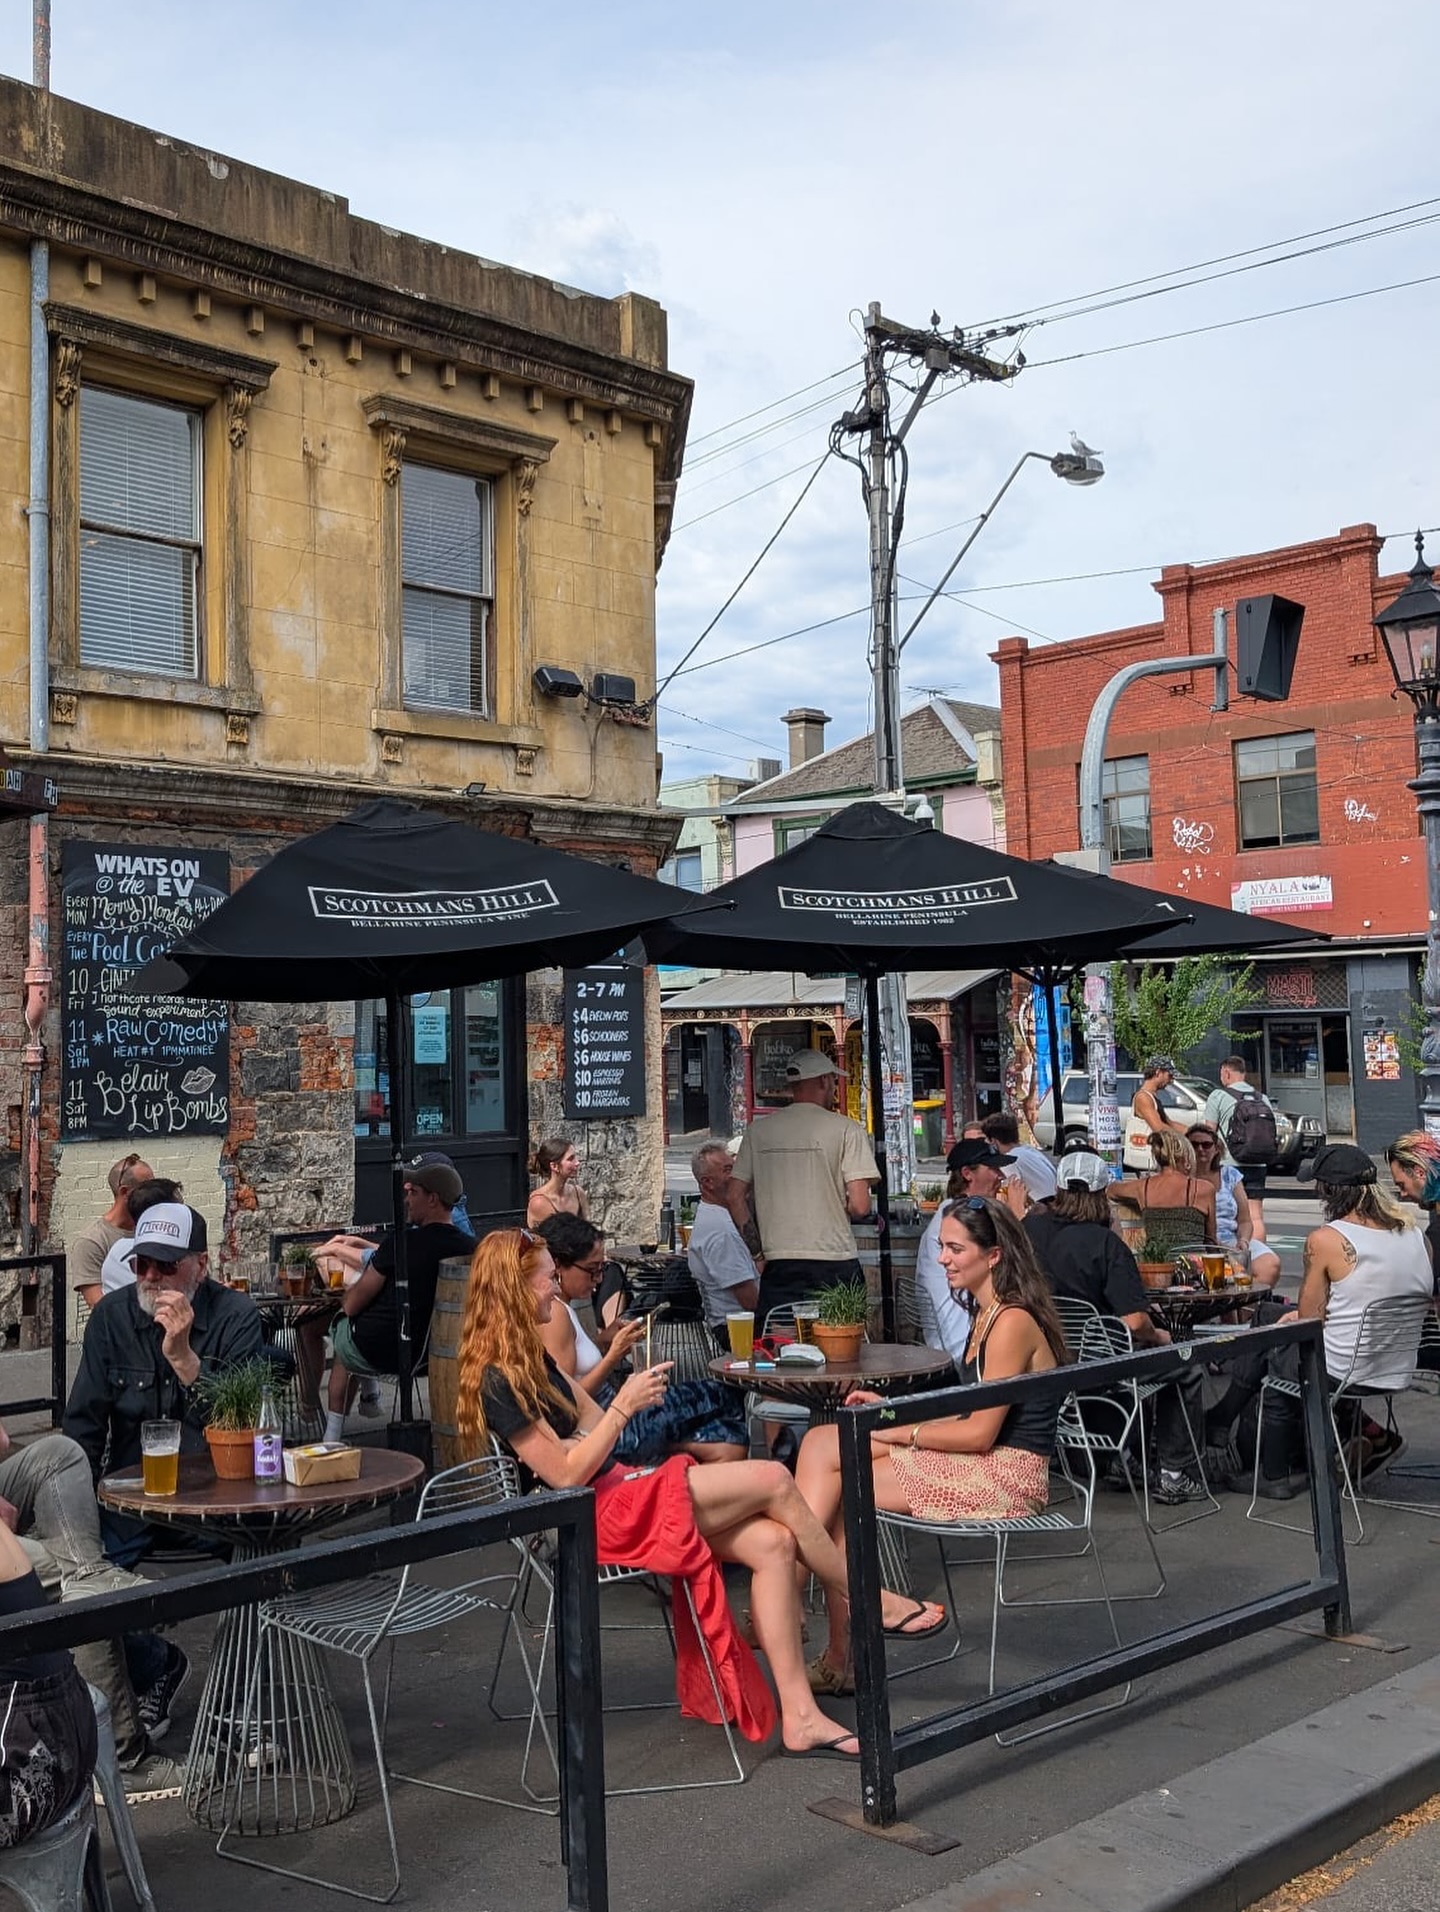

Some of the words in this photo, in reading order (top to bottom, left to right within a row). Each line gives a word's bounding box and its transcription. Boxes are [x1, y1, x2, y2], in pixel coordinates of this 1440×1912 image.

[95, 853, 168, 876] WHATS
[170, 859, 200, 878] ON
[95, 875, 114, 894] @
[118, 875, 146, 895] the
[157, 877, 194, 897] EV
[1250, 881, 1299, 896] NYALA
[66, 895, 90, 908] EVERY
[325, 894, 476, 914] SCOTCHMANS
[480, 891, 542, 912] HILL
[792, 893, 936, 908] SCOTCHMANS
[941, 886, 1001, 903] HILL
[66, 909, 88, 926] MON
[92, 895, 143, 923] Merry
[902, 910, 969, 919] PENINSULA
[66, 930, 92, 943] EVERY
[67, 945, 88, 960] Tue
[68, 968, 89, 995] 10
[576, 982, 606, 998] 2-7
[608, 982, 626, 998] PM
[68, 997, 85, 1010] Fri
[573, 1008, 588, 1025] $4
[68, 1019, 87, 1043] 11
[106, 1018, 142, 1044] Raw
[145, 1018, 218, 1045] Comedy
[573, 1028, 589, 1046] $6
[68, 1045, 88, 1058] Sat
[113, 1046, 141, 1058] HEAT
[573, 1049, 590, 1067] $6
[69, 1058, 90, 1069] 1PM
[574, 1069, 591, 1087] $10
[68, 1078, 84, 1100] 11
[93, 1063, 169, 1116] Belair
[65, 1102, 88, 1115] Sat
[575, 1091, 591, 1109] $10
[128, 1093, 164, 1132] Lip
[163, 1091, 228, 1132] Bombs
[416, 1112, 443, 1125] OPEN
[67, 1115, 88, 1129] 8PM
